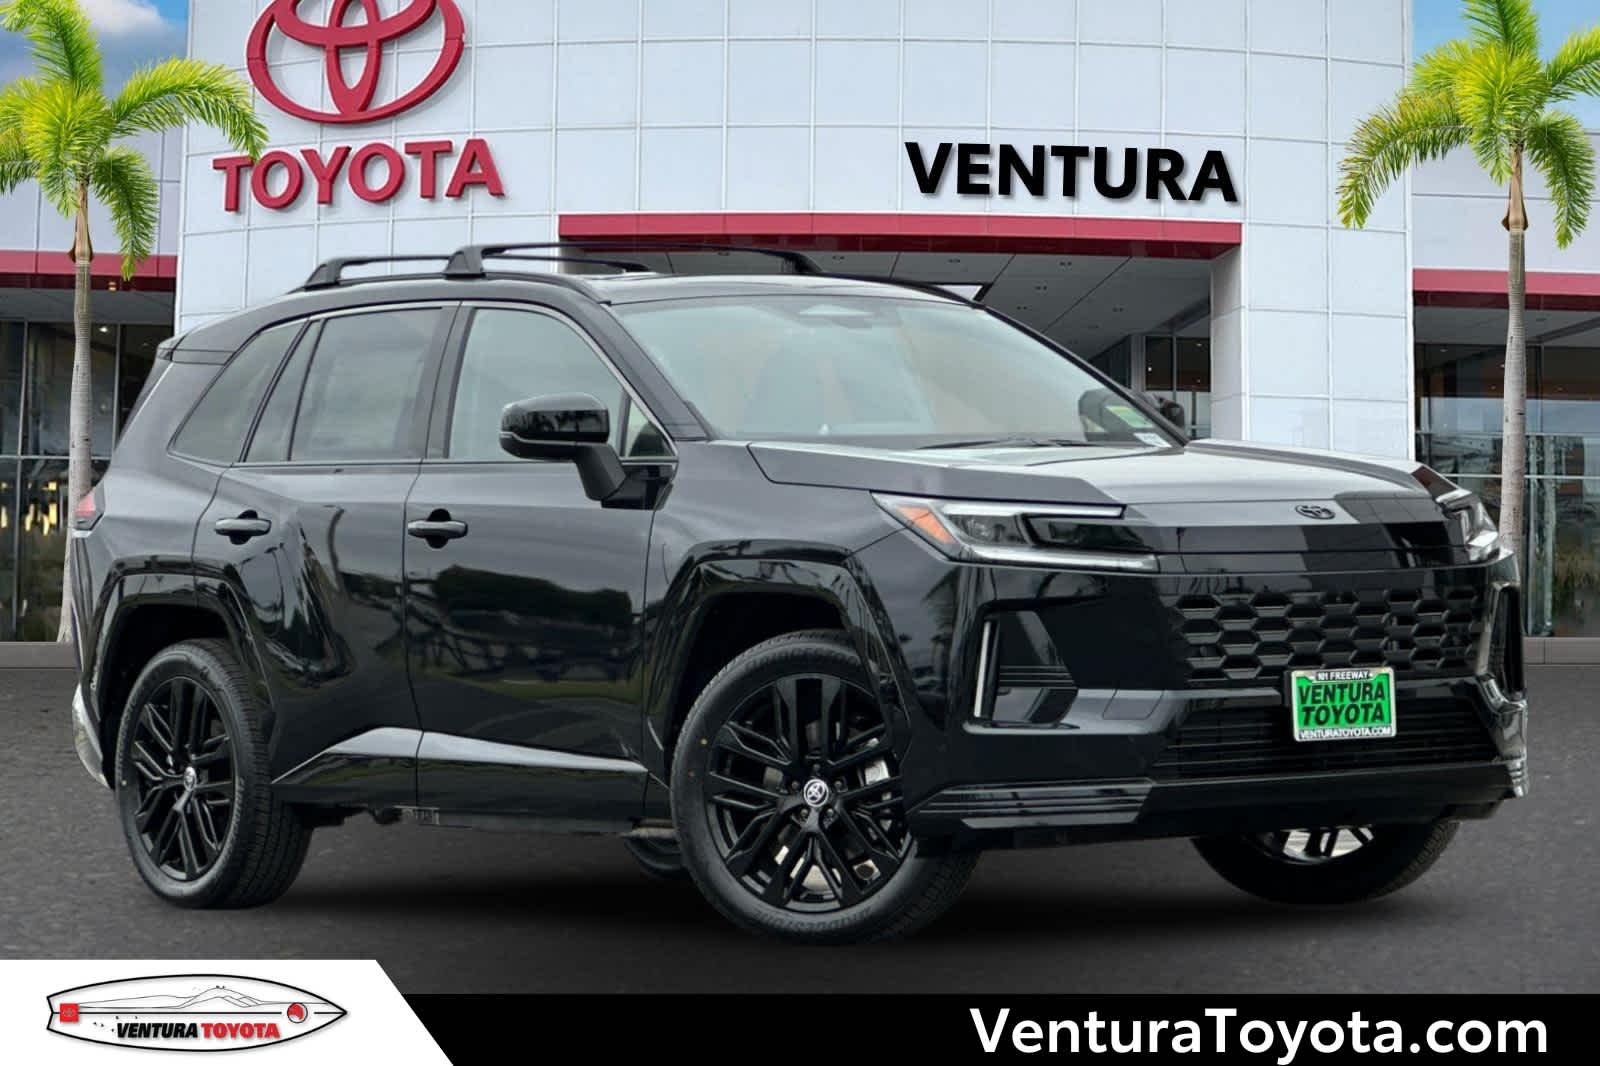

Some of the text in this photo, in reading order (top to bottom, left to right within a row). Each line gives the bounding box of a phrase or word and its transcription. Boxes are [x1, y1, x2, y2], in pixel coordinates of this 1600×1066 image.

[212, 138, 505, 212] TOYOTA
[904, 141, 1238, 202] VENTURA
[1330, 671, 1369, 680] FREEWAY
[1298, 682, 1386, 705] VENTURA
[1302, 703, 1385, 726] TOYOTA
[1300, 726, 1392, 739] VENTURATOYOTA.COM
